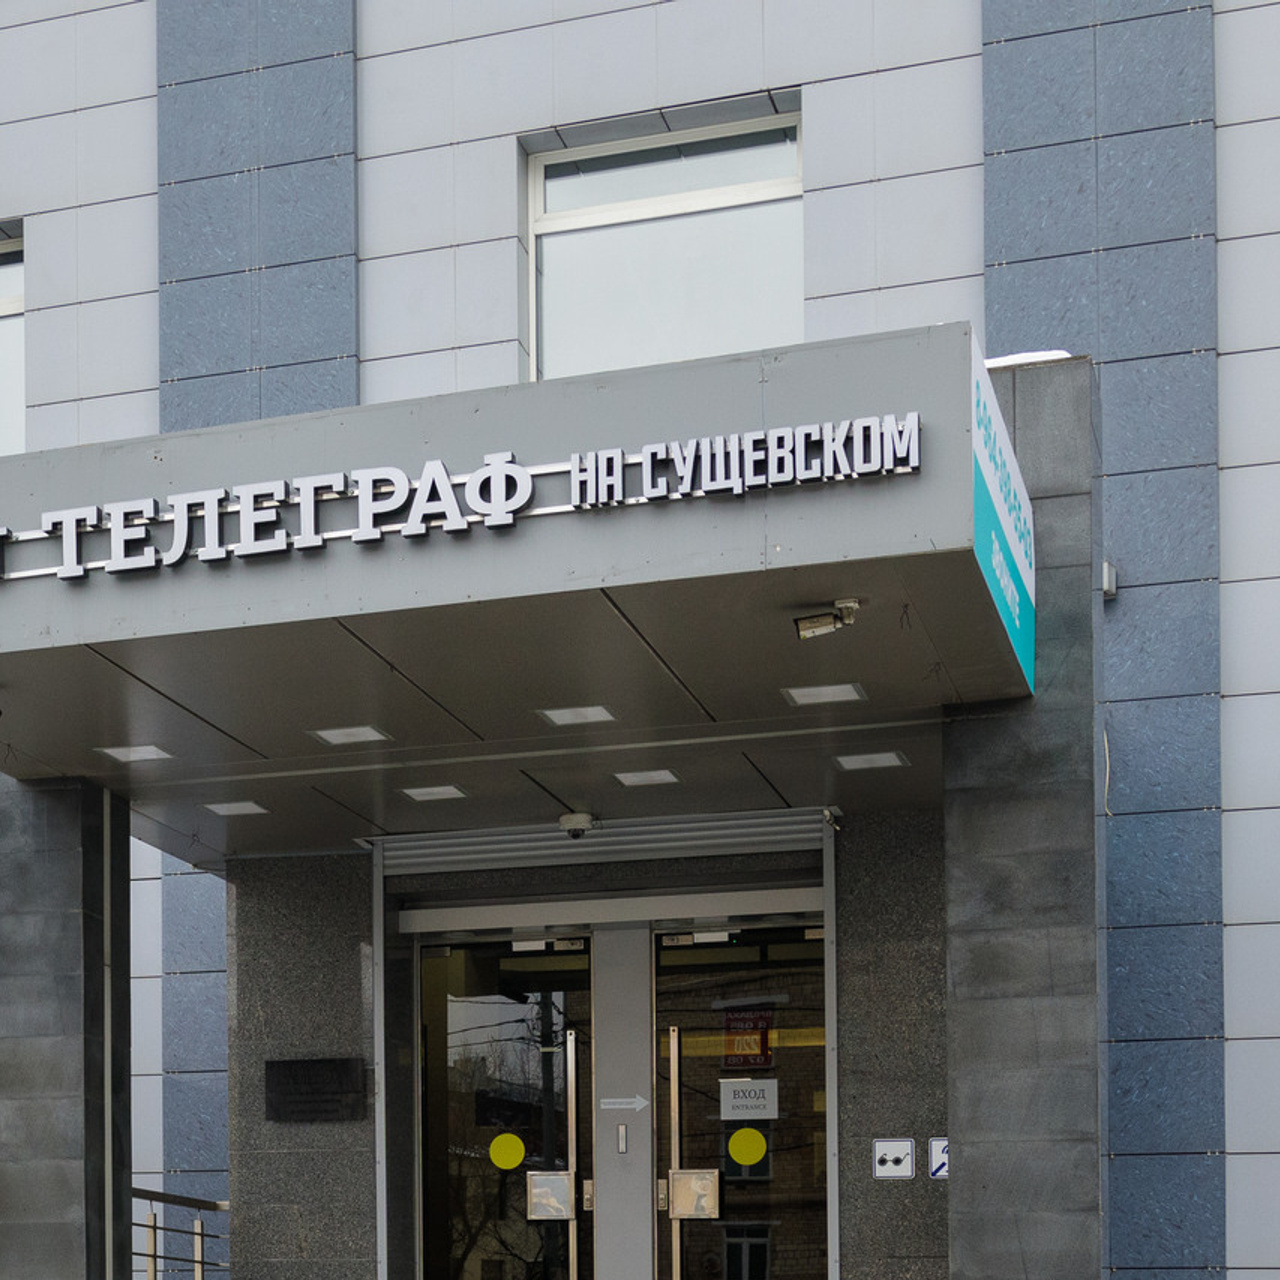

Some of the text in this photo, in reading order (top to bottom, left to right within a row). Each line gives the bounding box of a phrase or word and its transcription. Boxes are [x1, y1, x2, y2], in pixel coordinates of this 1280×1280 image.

[41, 451, 535, 580] ТЕЛЕГРАФ
[571, 447, 624, 508] НА
[641, 411, 921, 499] СУЩЕВСКОМ
[732, 1088, 766, 1101] ВХОД
[731, 1103, 768, 1111] ENTRANCE
